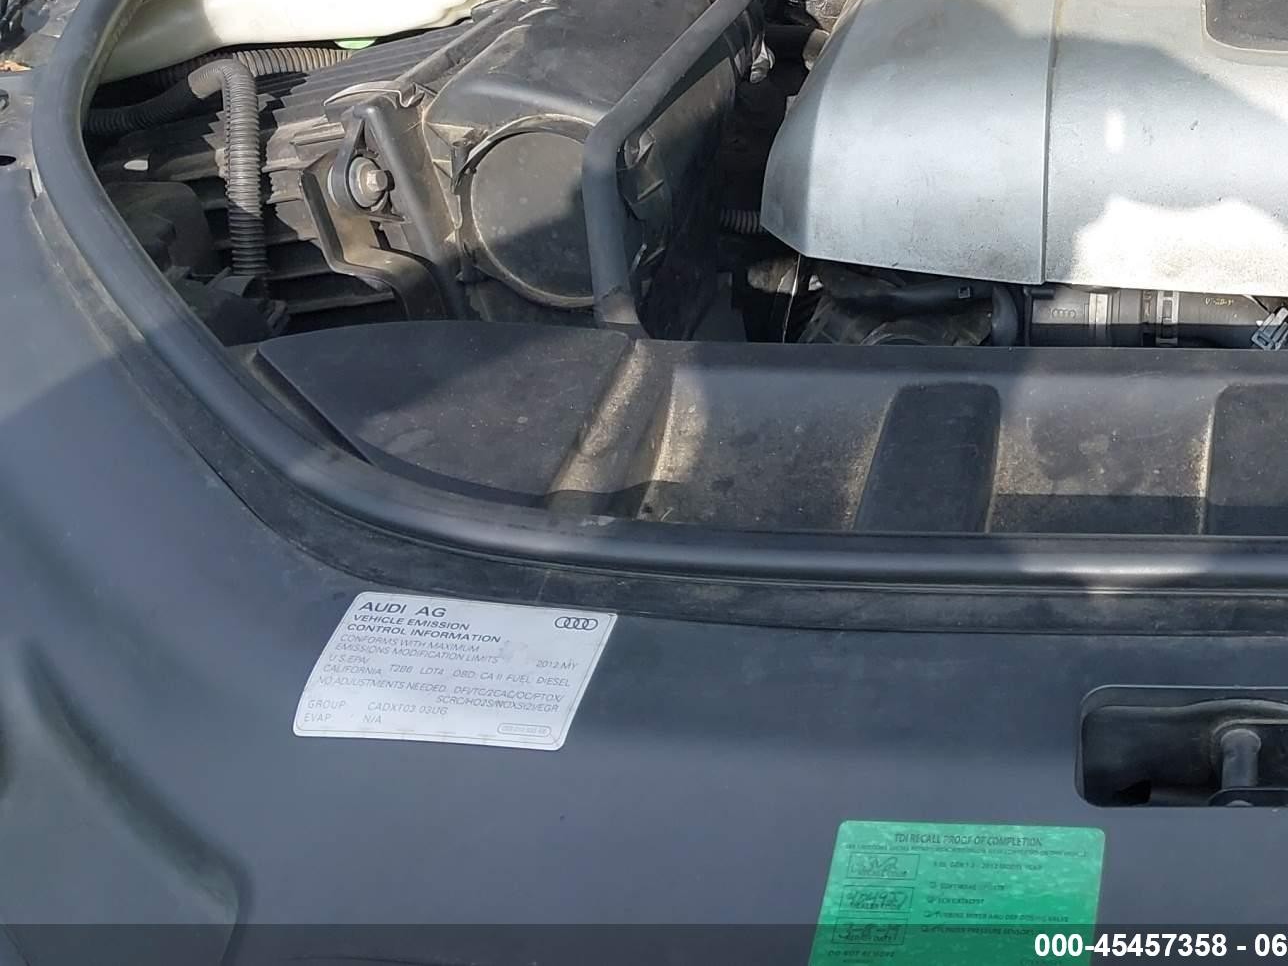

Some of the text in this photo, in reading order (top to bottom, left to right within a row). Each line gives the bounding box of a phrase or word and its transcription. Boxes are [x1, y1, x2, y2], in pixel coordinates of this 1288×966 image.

[358, 601, 447, 618] AUDI AG
[354, 614, 470, 631] VEHICLE EMISSION
[347, 624, 501, 643] CONTROL INFORMATION
[336, 643, 390, 655] EMISSIONS
[391, 647, 464, 661] MODIFICATION
[340, 634, 480, 653] CONFORMS WITH MAXIMUM
[323, 664, 382, 675] CALIFORNIA
[910, 834, 941, 844] RECALL
[987, 836, 1042, 847] COMPLETION
